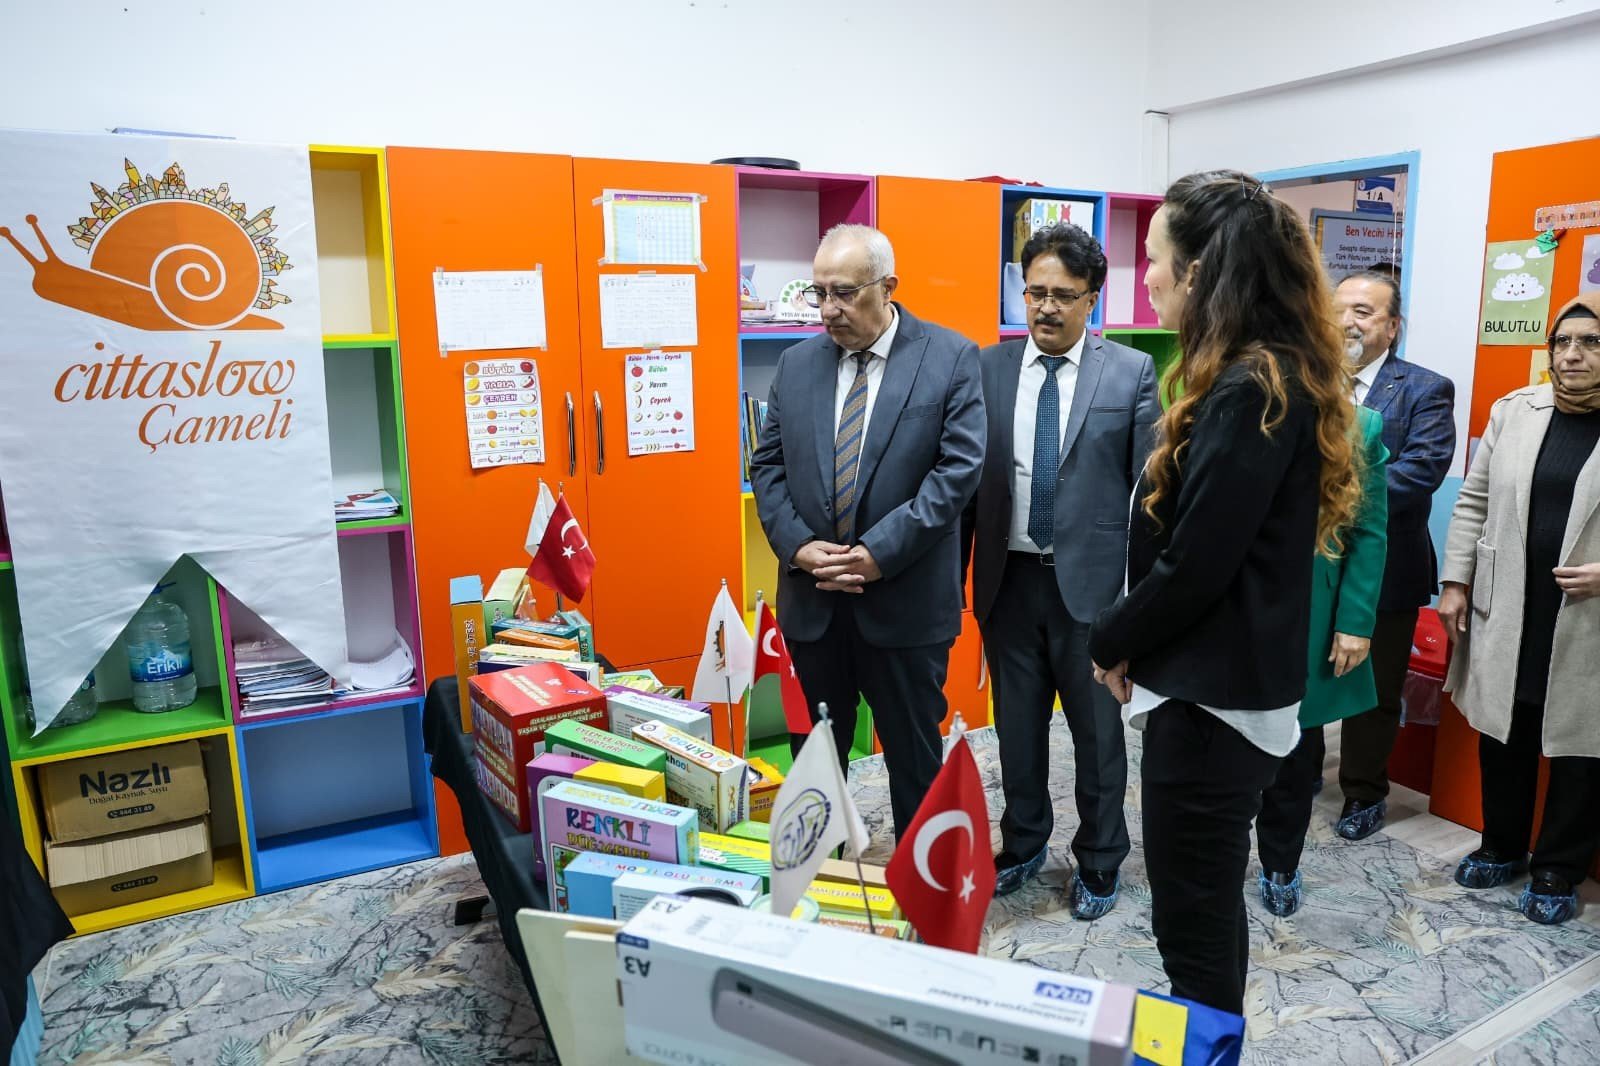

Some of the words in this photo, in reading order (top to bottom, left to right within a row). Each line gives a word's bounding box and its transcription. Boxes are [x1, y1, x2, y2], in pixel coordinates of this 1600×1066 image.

[1345, 225, 1360, 237] Ben
[1362, 226, 1385, 238] Vecihi
[1484, 320, 1541, 334] BULUTLU
[54, 341, 295, 403] cittaslow
[482, 362, 515, 375] BÜTÜN
[483, 380, 516, 390] YARIM
[137, 399, 294, 454] Çameli
[146, 655, 182, 674] Erikli
[79, 762, 171, 798] Nazlı
[88, 794, 114, 805] Doğal
[115, 789, 146, 801] Kaynak
[148, 786, 168, 794] Suyu
[143, 804, 153, 812] 49
[623, 955, 651, 979] A3
